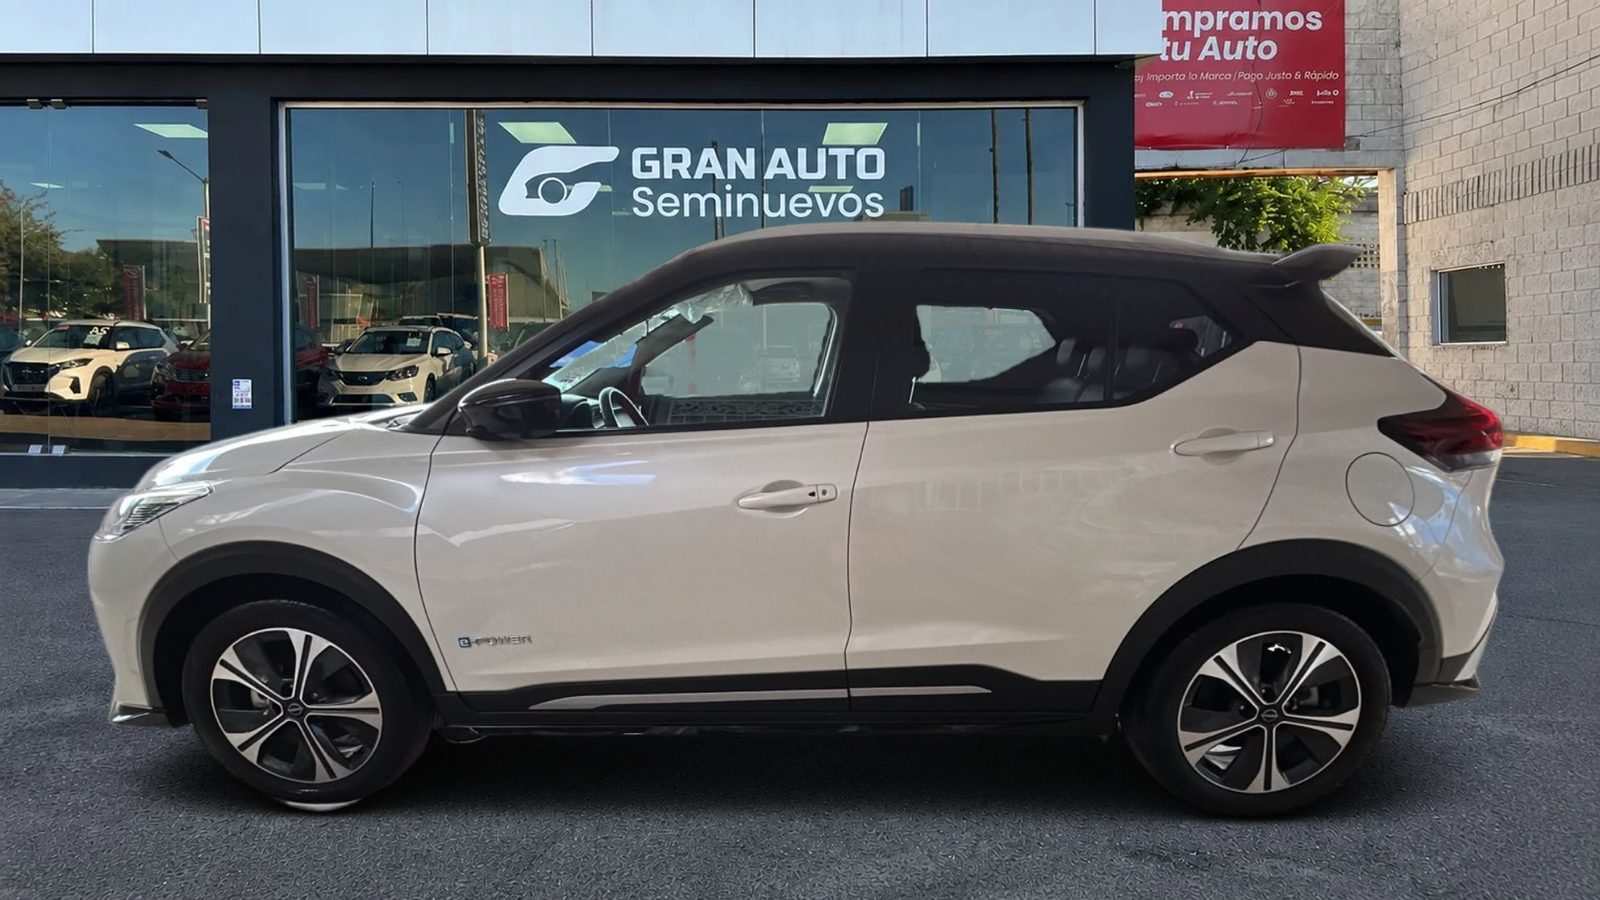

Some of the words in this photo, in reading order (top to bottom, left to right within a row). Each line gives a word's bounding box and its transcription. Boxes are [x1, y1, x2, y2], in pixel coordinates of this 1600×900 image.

[1162, 10, 1322, 38] mpramos
[1160, 37, 1191, 61] tu
[1197, 35, 1277, 61] Auto
[1146, 72, 1185, 83] Importa
[1189, 72, 1198, 80] la
[1200, 72, 1232, 80] Marca
[1265, 71, 1292, 80] Justo
[1294, 71, 1302, 80] &
[631, 146, 756, 180] GRAN
[763, 146, 886, 180] AUTO
[631, 183, 885, 218] Seminuevos
